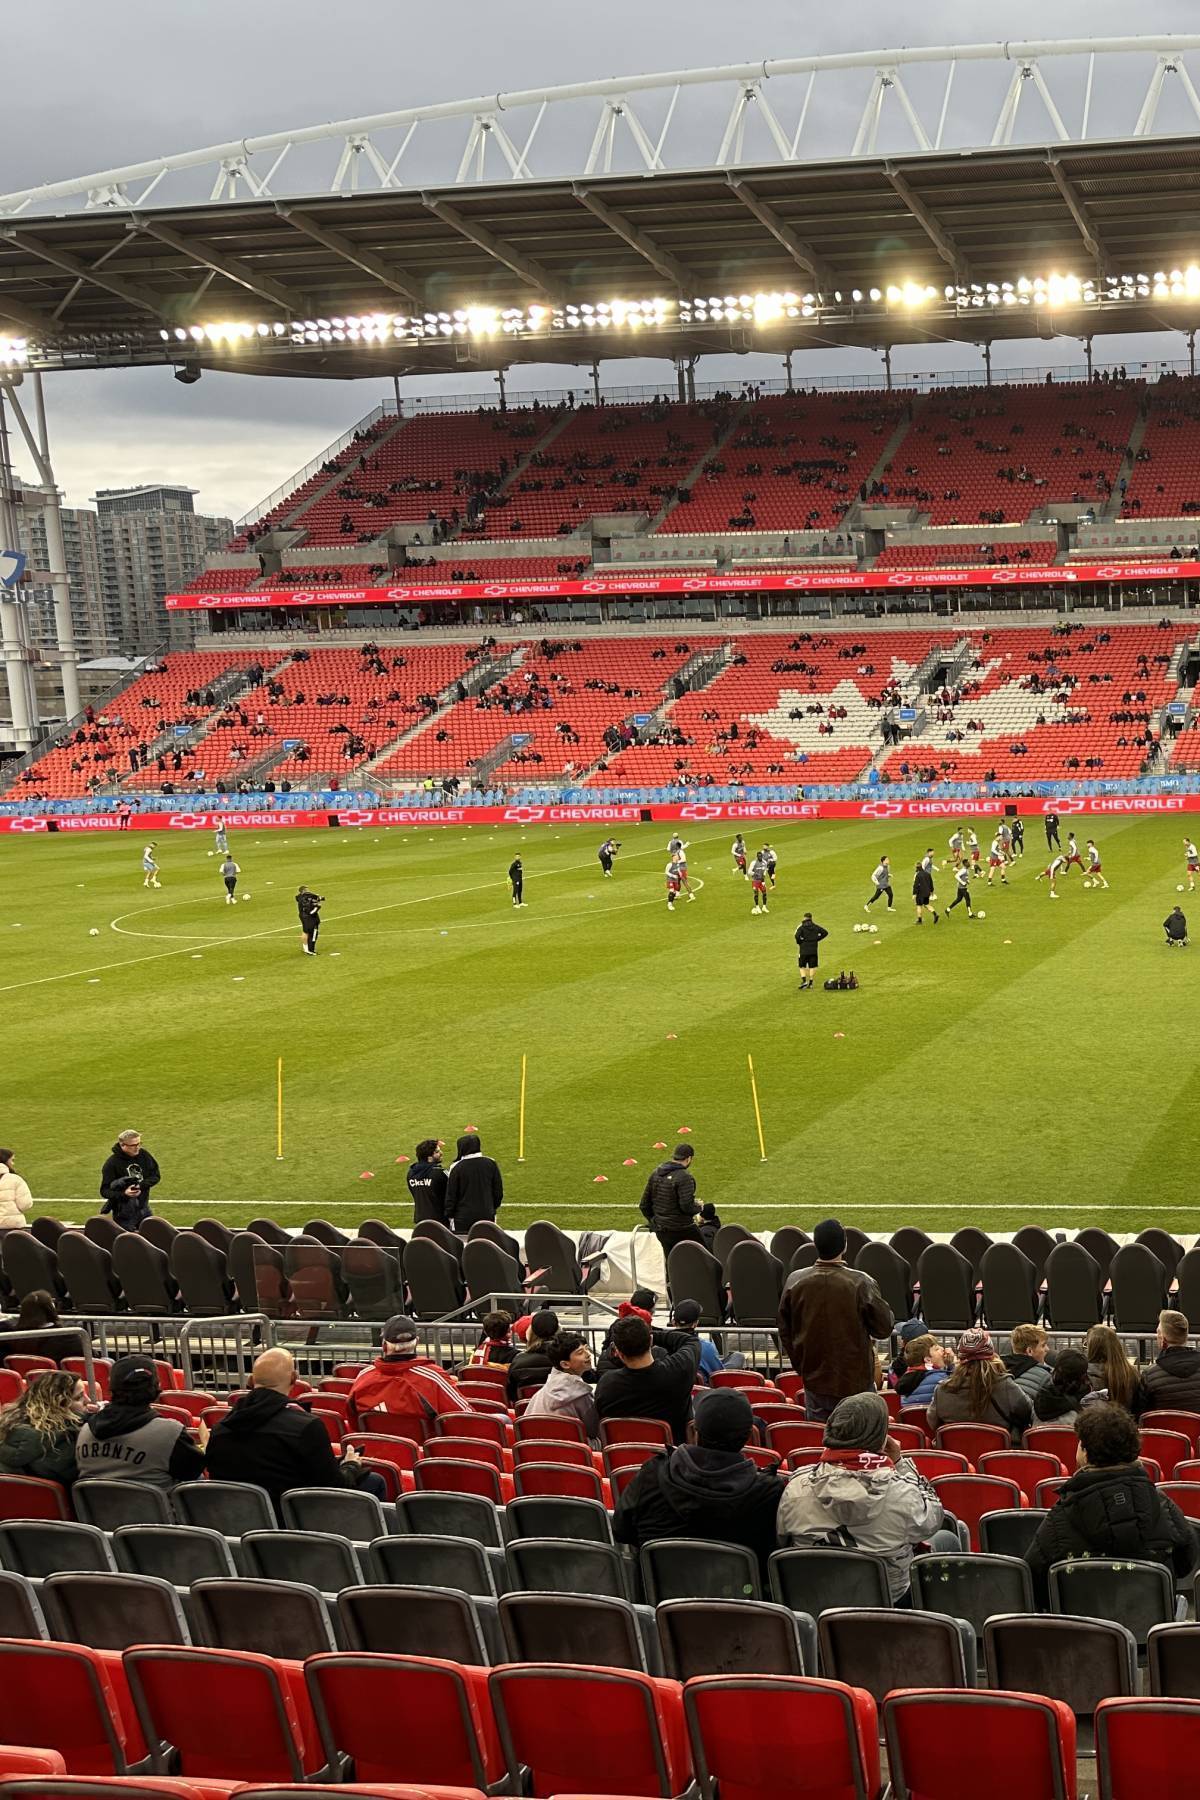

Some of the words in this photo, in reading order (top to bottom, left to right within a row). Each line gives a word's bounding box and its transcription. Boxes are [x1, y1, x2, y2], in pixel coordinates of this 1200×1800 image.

[1125, 566, 1179, 576] CHEVROLET
[812, 576, 865, 585] CHEVROLET
[915, 573, 969, 582] CHEVROLET
[609, 581, 660, 590] CHEVROLET
[710, 579, 762, 587] CHEVROLET
[413, 588, 462, 596] CHEVROLET
[510, 584, 560, 593] CHEVROLET
[223, 595, 272, 604] CHEVROLET
[317, 592, 366, 600] CHEVROLET
[909, 802, 1002, 813] CHEVROLET
[1091, 798, 1186, 809] CHEVROLET
[550, 808, 641, 819] CHEVROLET
[728, 805, 820, 816] CHEVROLET
[379, 811, 464, 822] CHEVROLET
[55, 817, 133, 828] HEVROLE
